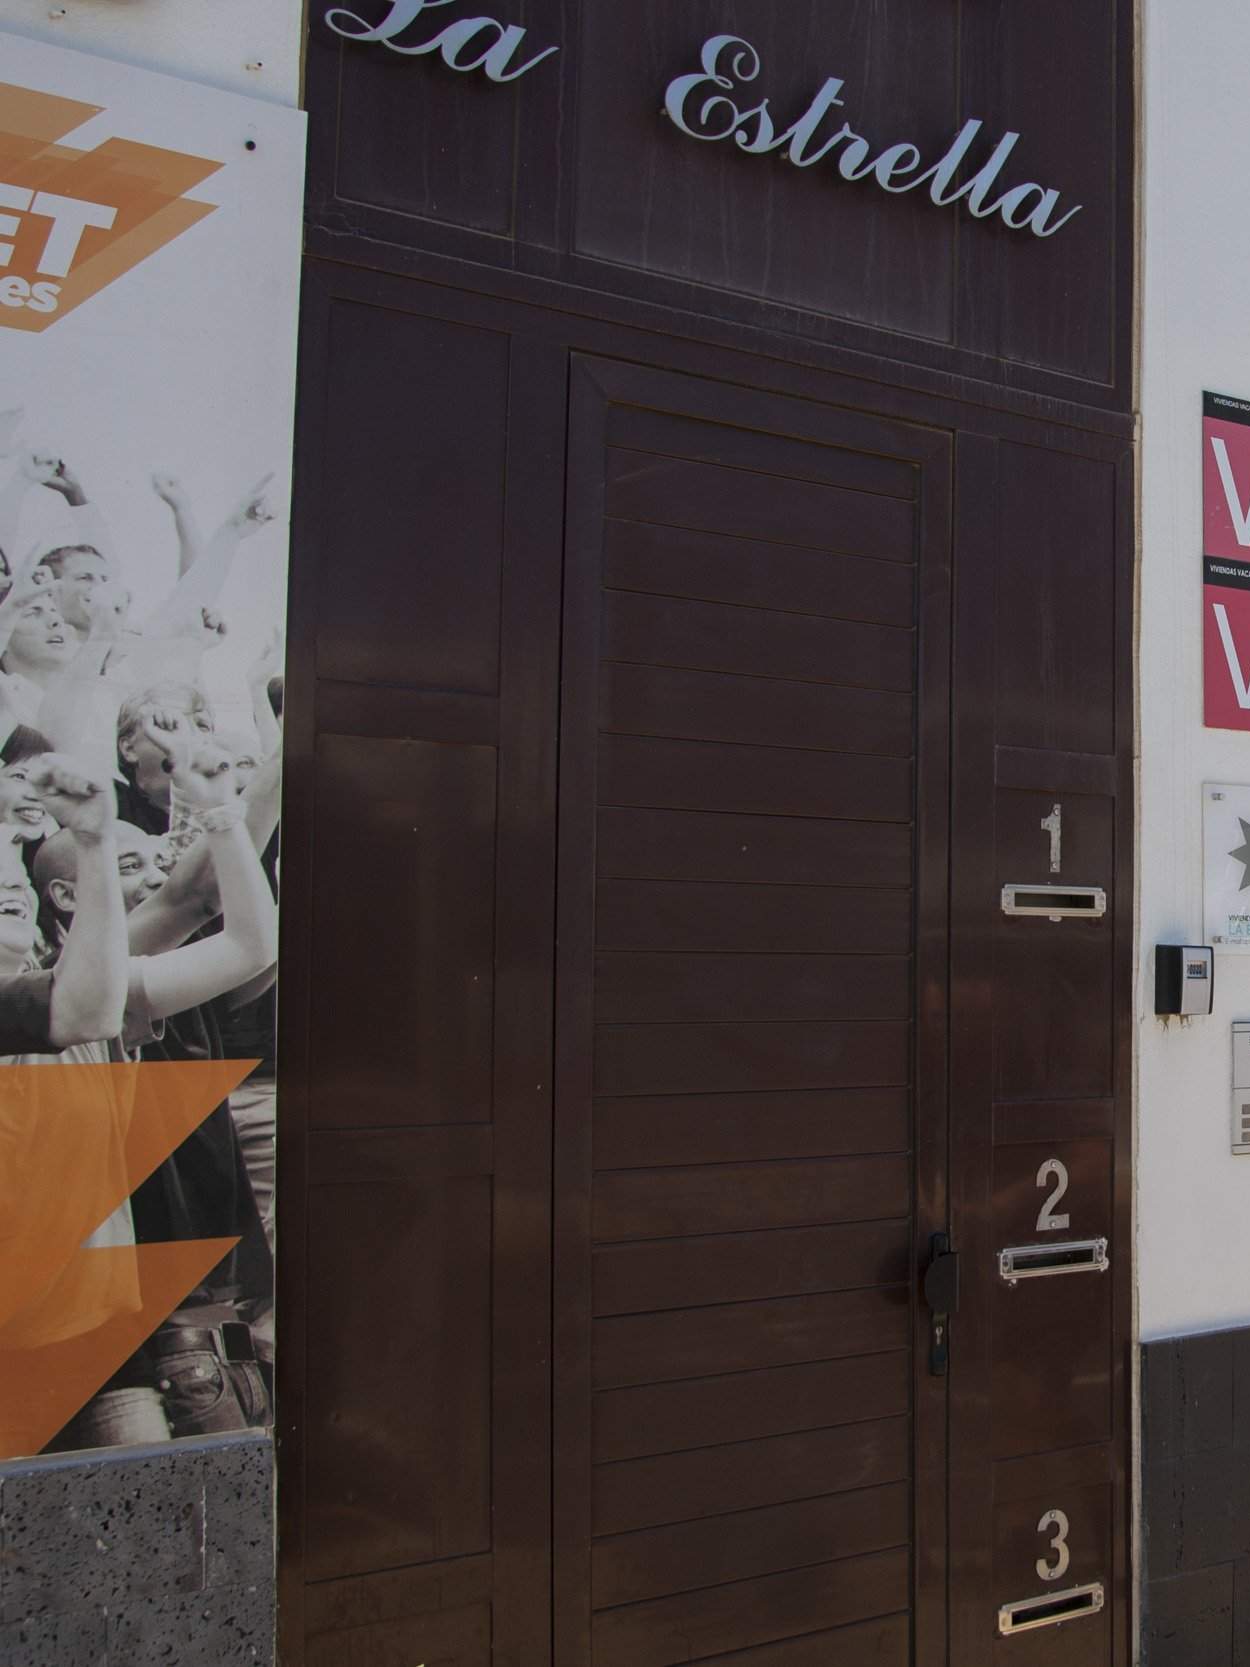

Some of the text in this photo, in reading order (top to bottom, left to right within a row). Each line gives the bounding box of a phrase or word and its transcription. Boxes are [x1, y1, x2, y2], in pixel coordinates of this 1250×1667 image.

[664, 34, 1083, 237] Estrella
[1213, 398, 1239, 409] VIVIENDAS
[1209, 564, 1237, 577] VIVIENDAS
[1041, 804, 1061, 873] 1
[1229, 925, 1243, 936] LA
[1036, 1158, 1069, 1231] 2
[1036, 1508, 1069, 1580] 3
